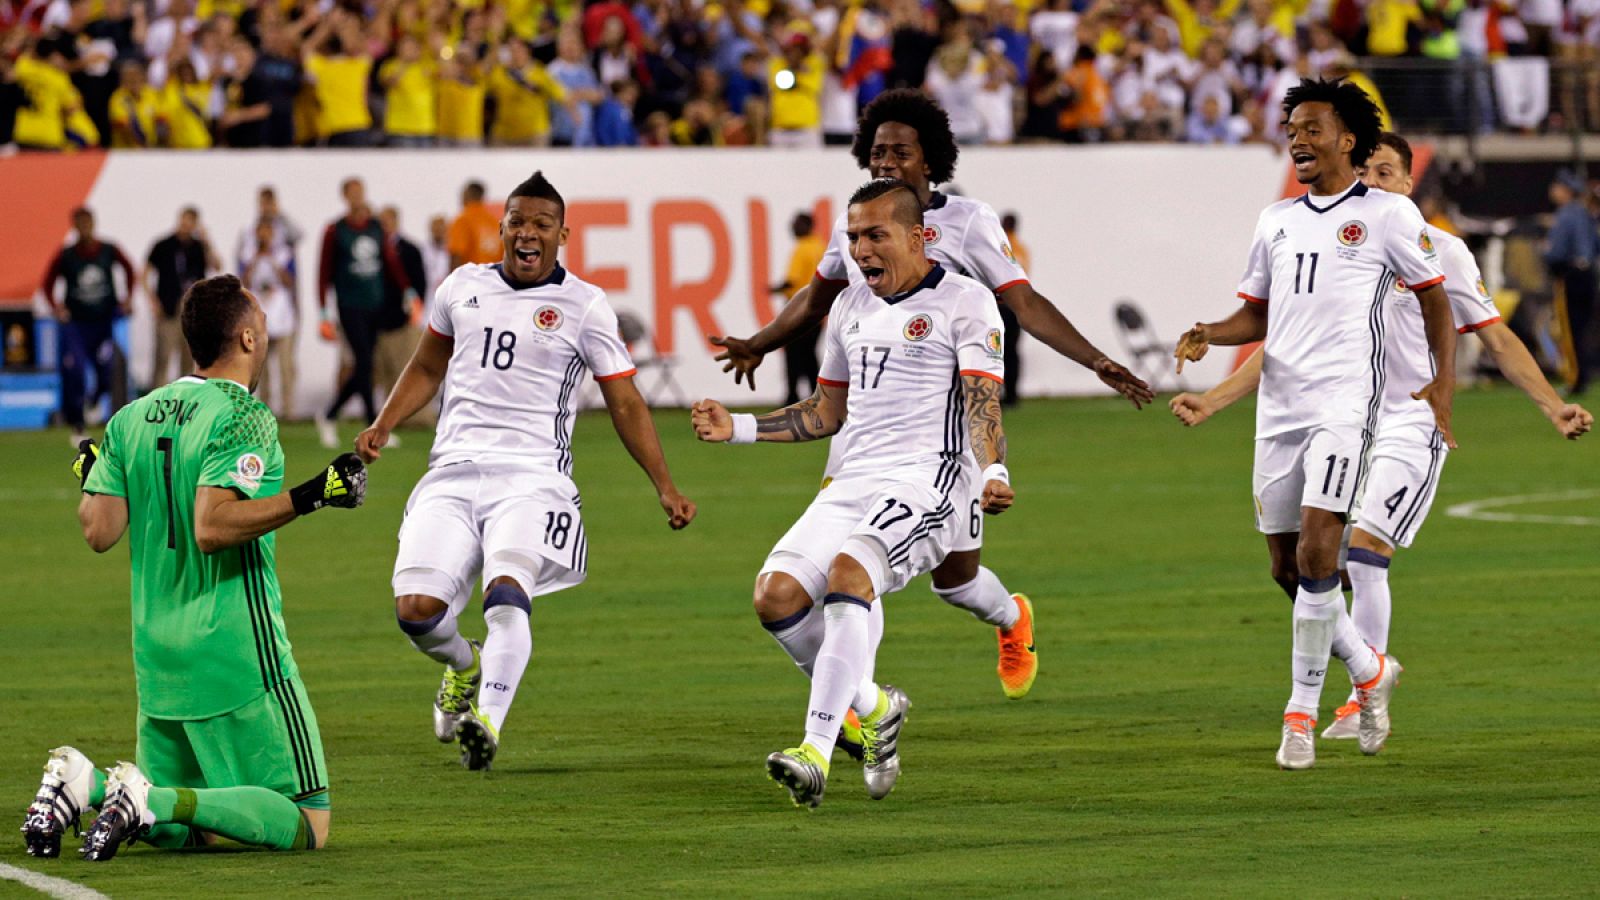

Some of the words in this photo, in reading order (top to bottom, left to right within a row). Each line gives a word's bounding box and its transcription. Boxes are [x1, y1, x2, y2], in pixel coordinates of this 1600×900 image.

[485, 198, 832, 356] ERU
[1294, 252, 1319, 295] 11
[481, 326, 517, 371] 18
[861, 346, 891, 390] 17
[156, 436, 177, 549] 1
[1322, 454, 1350, 498] 11
[869, 498, 913, 530] 17
[970, 498, 980, 539] 6
[1384, 486, 1408, 520] 4
[543, 511, 572, 550] 18
[485, 681, 511, 692] FCF
